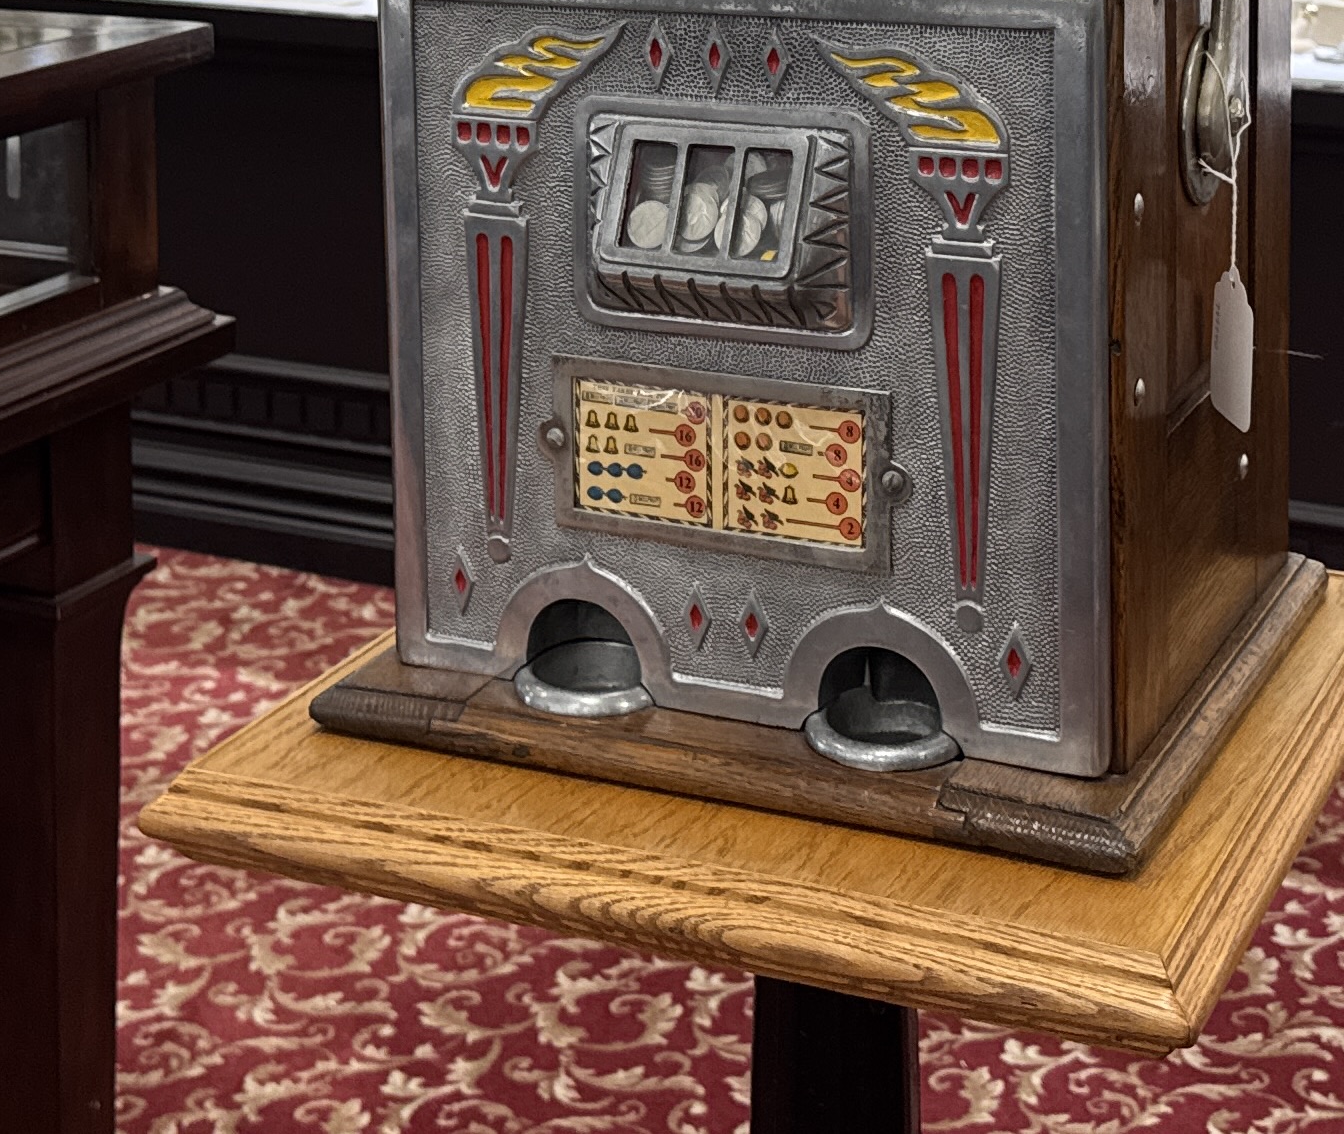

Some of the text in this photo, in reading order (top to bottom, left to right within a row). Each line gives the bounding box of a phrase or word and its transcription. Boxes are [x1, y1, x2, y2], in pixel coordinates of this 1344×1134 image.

[679, 429, 693, 443] 16
[846, 425, 854, 438] 8
[688, 454, 702, 467] 16
[833, 449, 842, 462] 8
[678, 476, 692, 490] 12
[690, 501, 704, 514] 12
[832, 497, 840, 510] 4
[847, 522, 855, 535] 2
